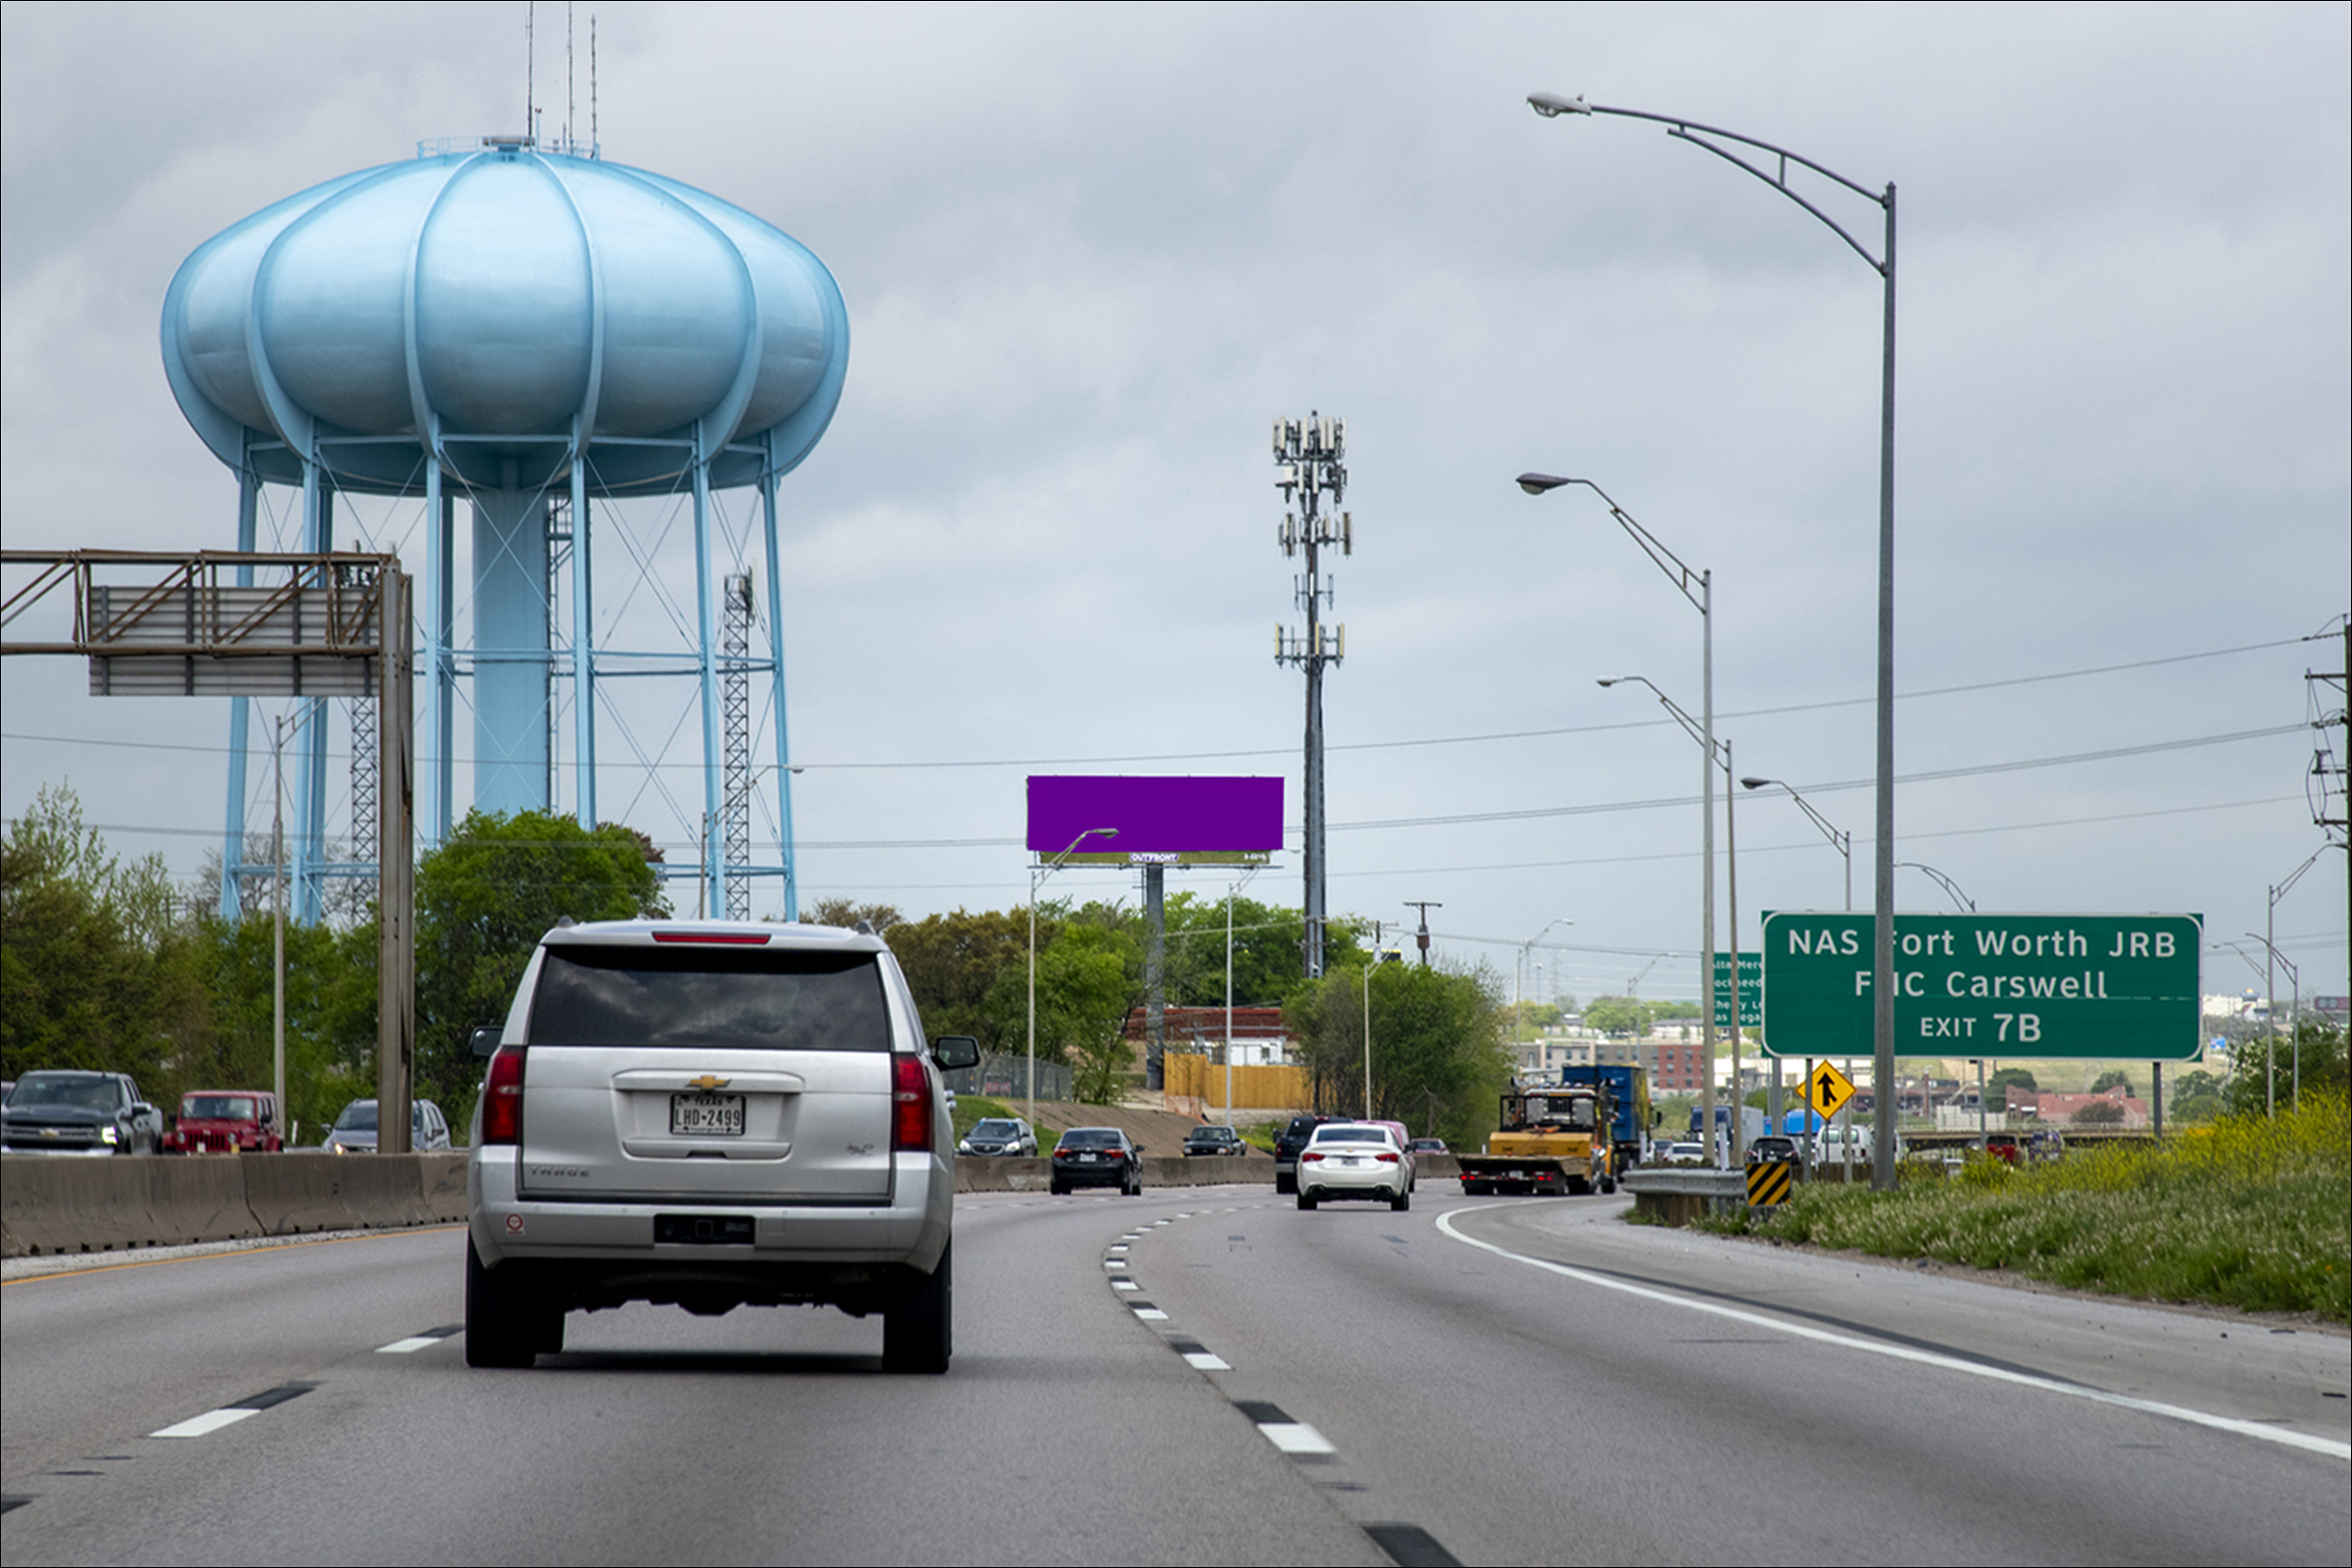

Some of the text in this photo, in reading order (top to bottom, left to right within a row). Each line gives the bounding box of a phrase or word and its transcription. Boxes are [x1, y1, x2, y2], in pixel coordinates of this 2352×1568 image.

[1788, 929, 2176, 957] NAS ort Worth JRB
[1712, 960, 1733, 969] lta
[1855, 970, 2108, 999] FC Carswell
[1714, 1013, 1729, 1022] as
[1921, 1013, 2041, 1042] EXIT 7B
[694, 1096, 723, 1106] TEXAS
[530, 1166, 589, 1177] TAHOE
